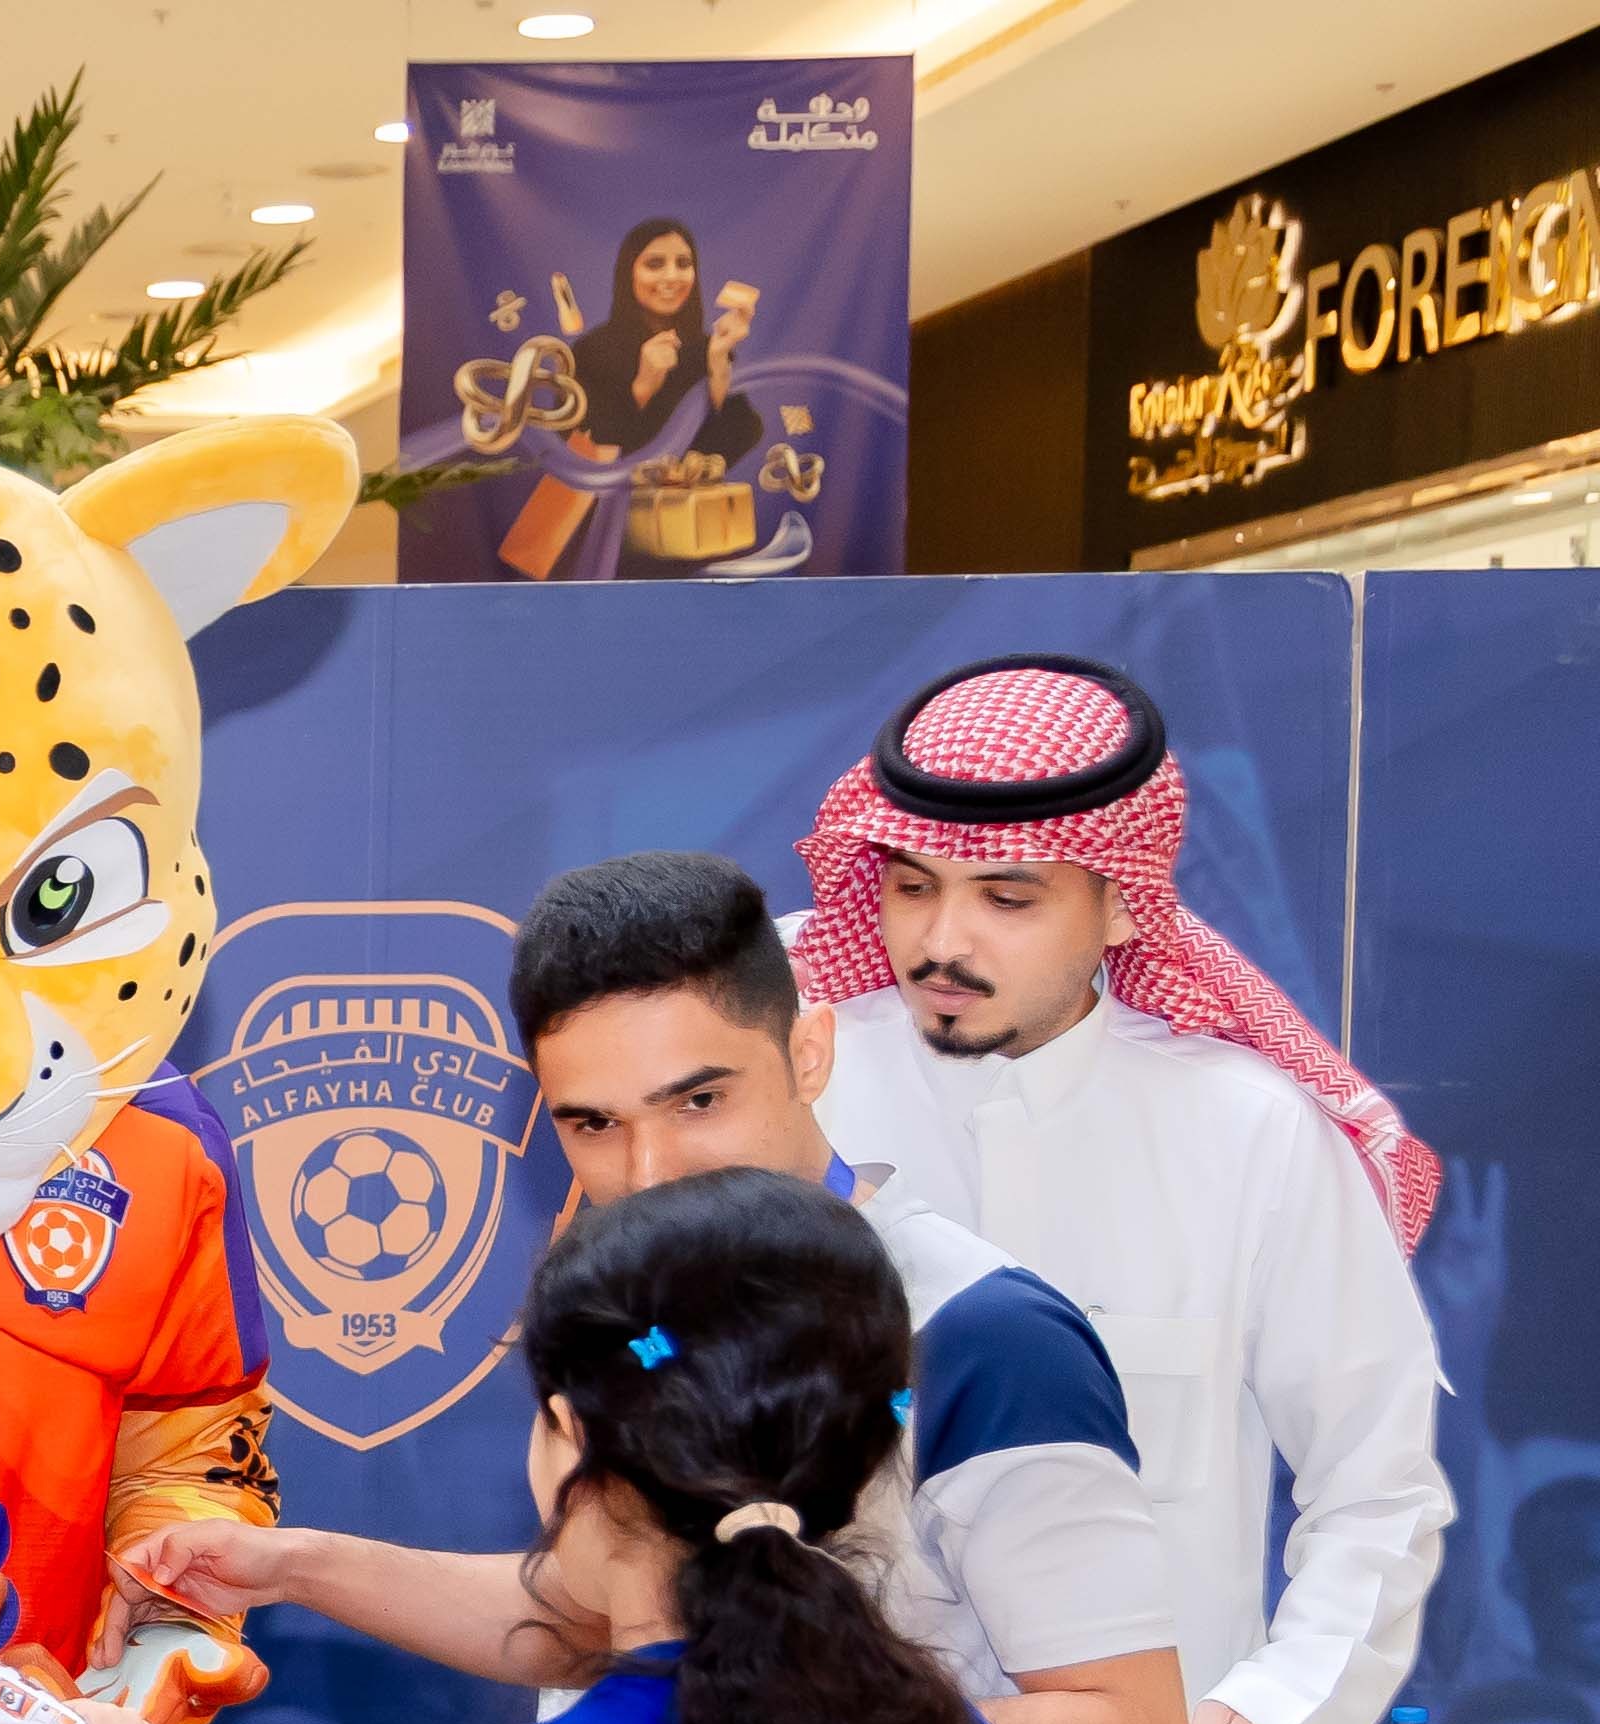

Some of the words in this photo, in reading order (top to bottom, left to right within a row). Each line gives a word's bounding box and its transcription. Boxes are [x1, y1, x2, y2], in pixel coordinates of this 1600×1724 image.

[232, 1034, 404, 1095] الفيحاء
[413, 1050, 512, 1092] نادي
[241, 1079, 394, 1128] ALFAYHA
[409, 1084, 496, 1126] CLUB
[74, 1191, 112, 1214] CLUB
[46, 1290, 69, 1304] 1953
[341, 1313, 397, 1338] 1953
